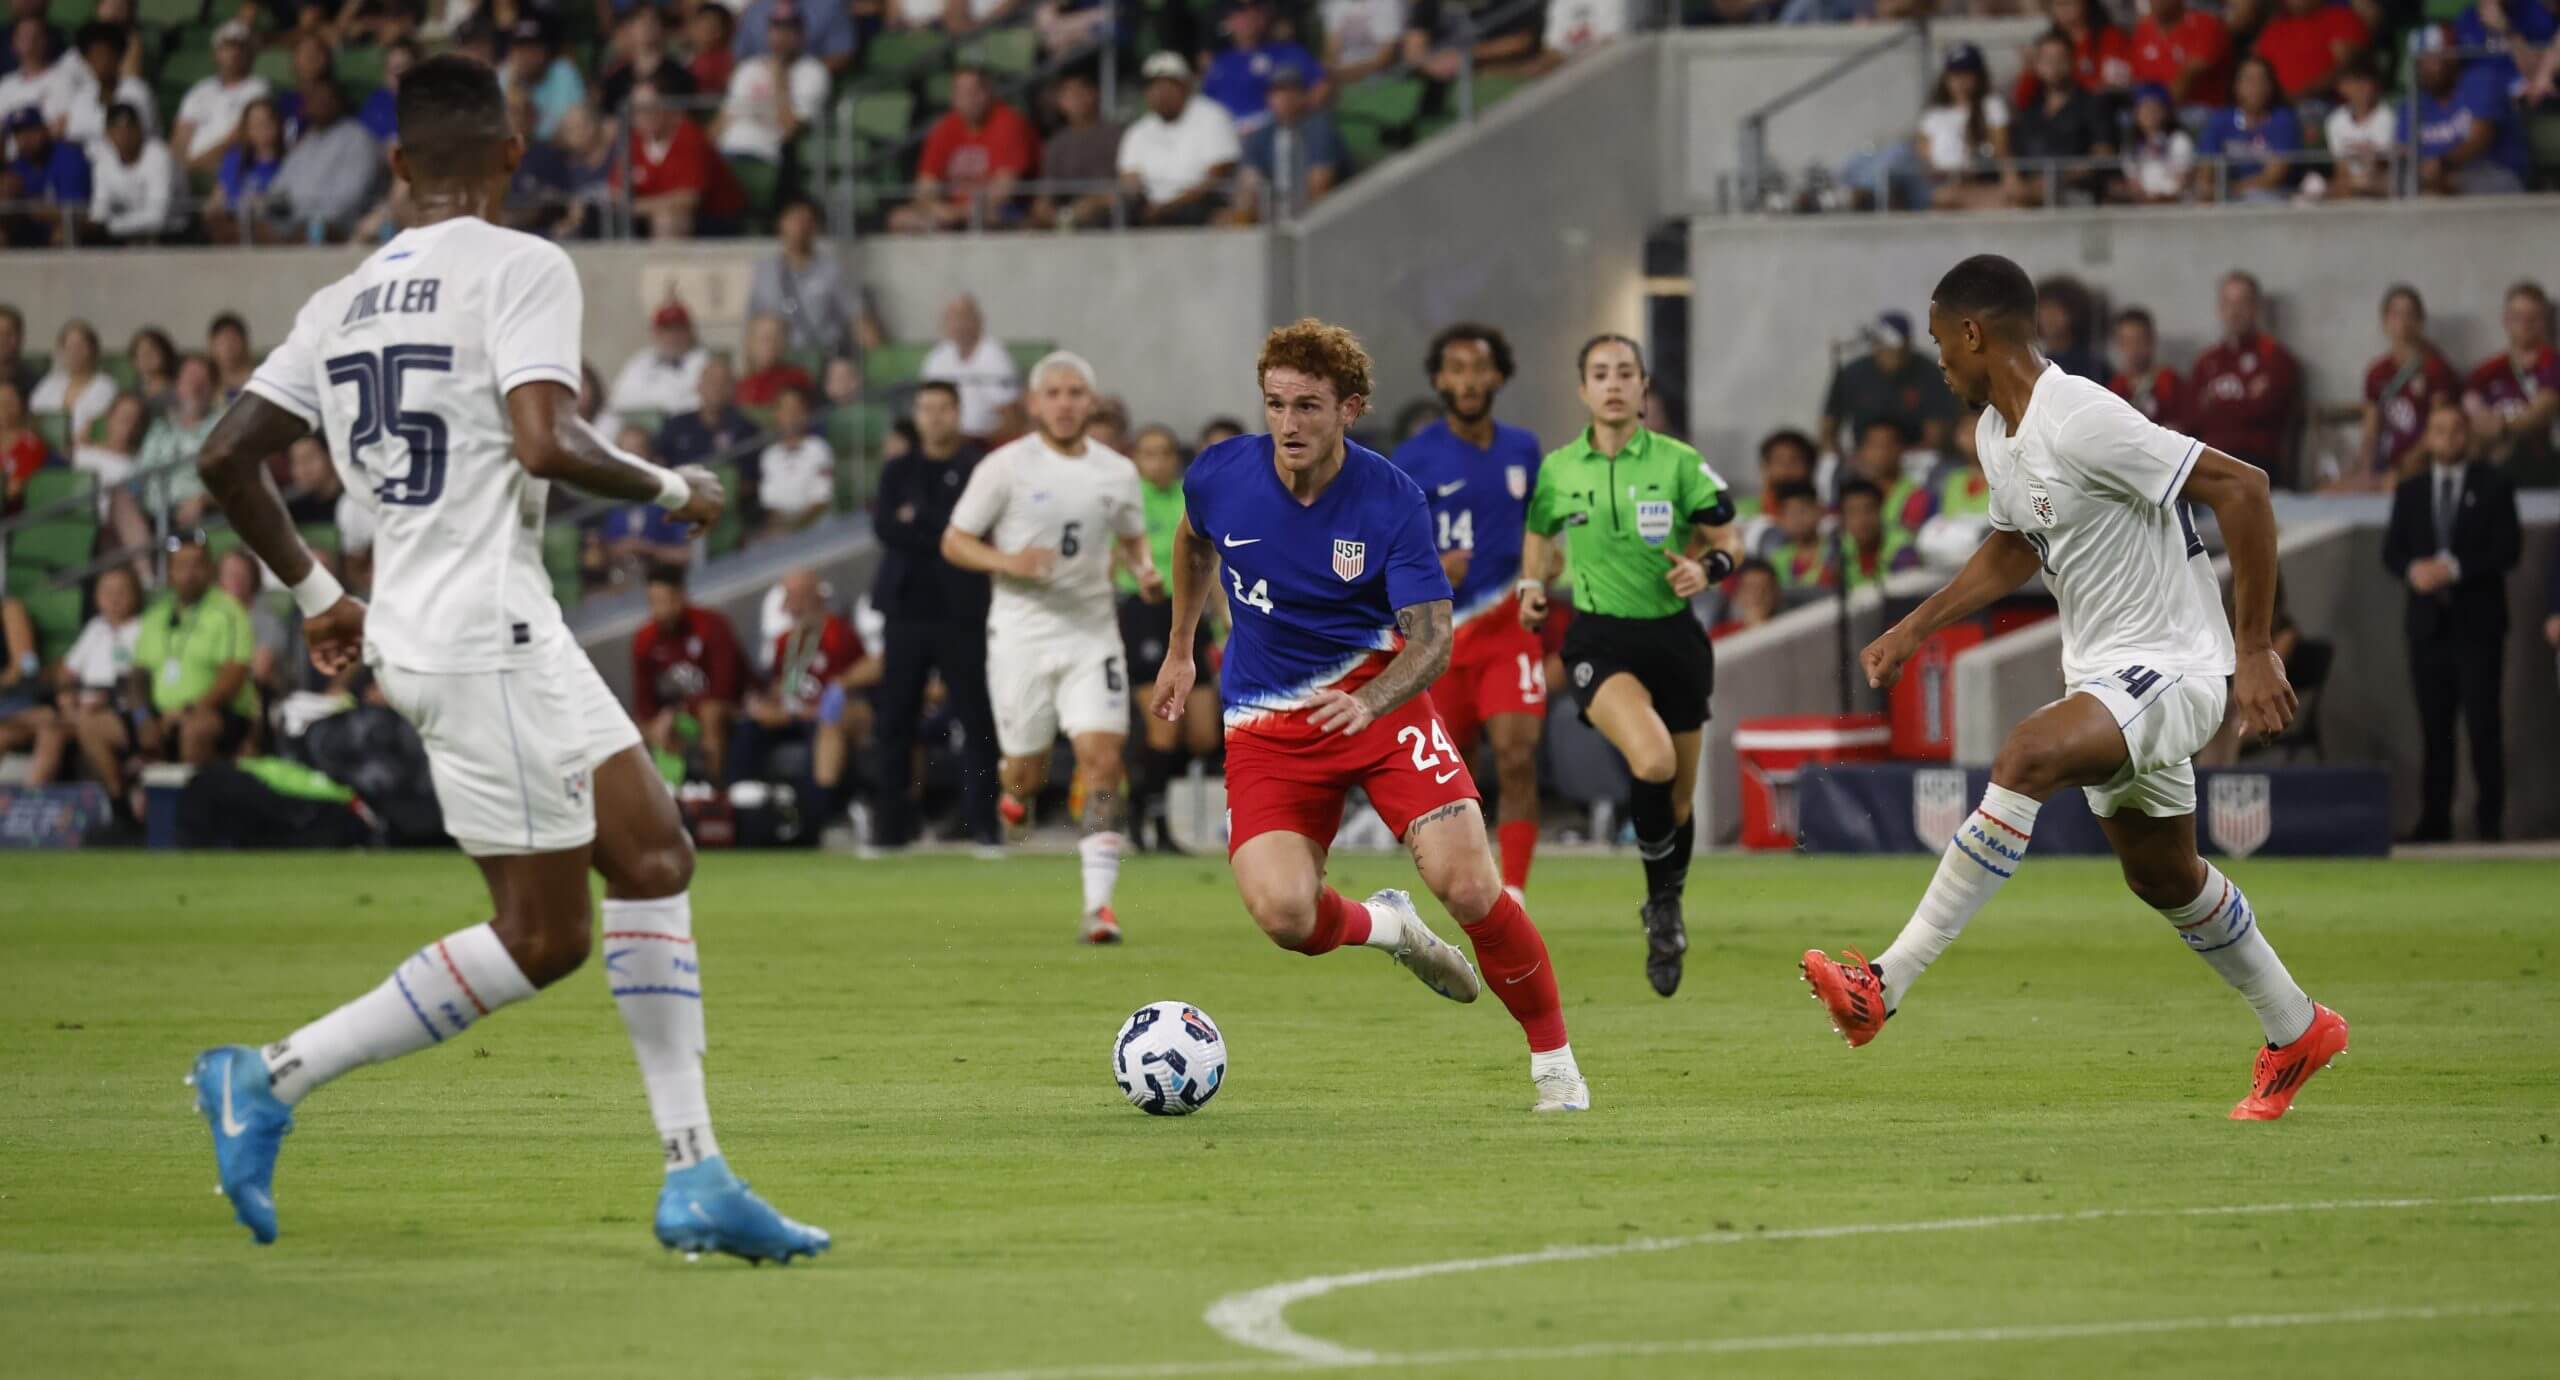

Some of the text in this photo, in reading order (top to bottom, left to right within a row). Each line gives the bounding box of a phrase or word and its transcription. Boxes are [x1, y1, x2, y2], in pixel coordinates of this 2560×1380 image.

[325, 343, 454, 507] 25
[1640, 504, 1669, 515] FIFA
[1061, 520, 1082, 558] 6
[1437, 508, 1475, 550] 14
[1336, 541, 1363, 558] USA
[1228, 565, 1274, 615] 24
[1105, 656, 1123, 692] 6
[2112, 665, 2163, 700] 4
[1397, 718, 1460, 772] 24
